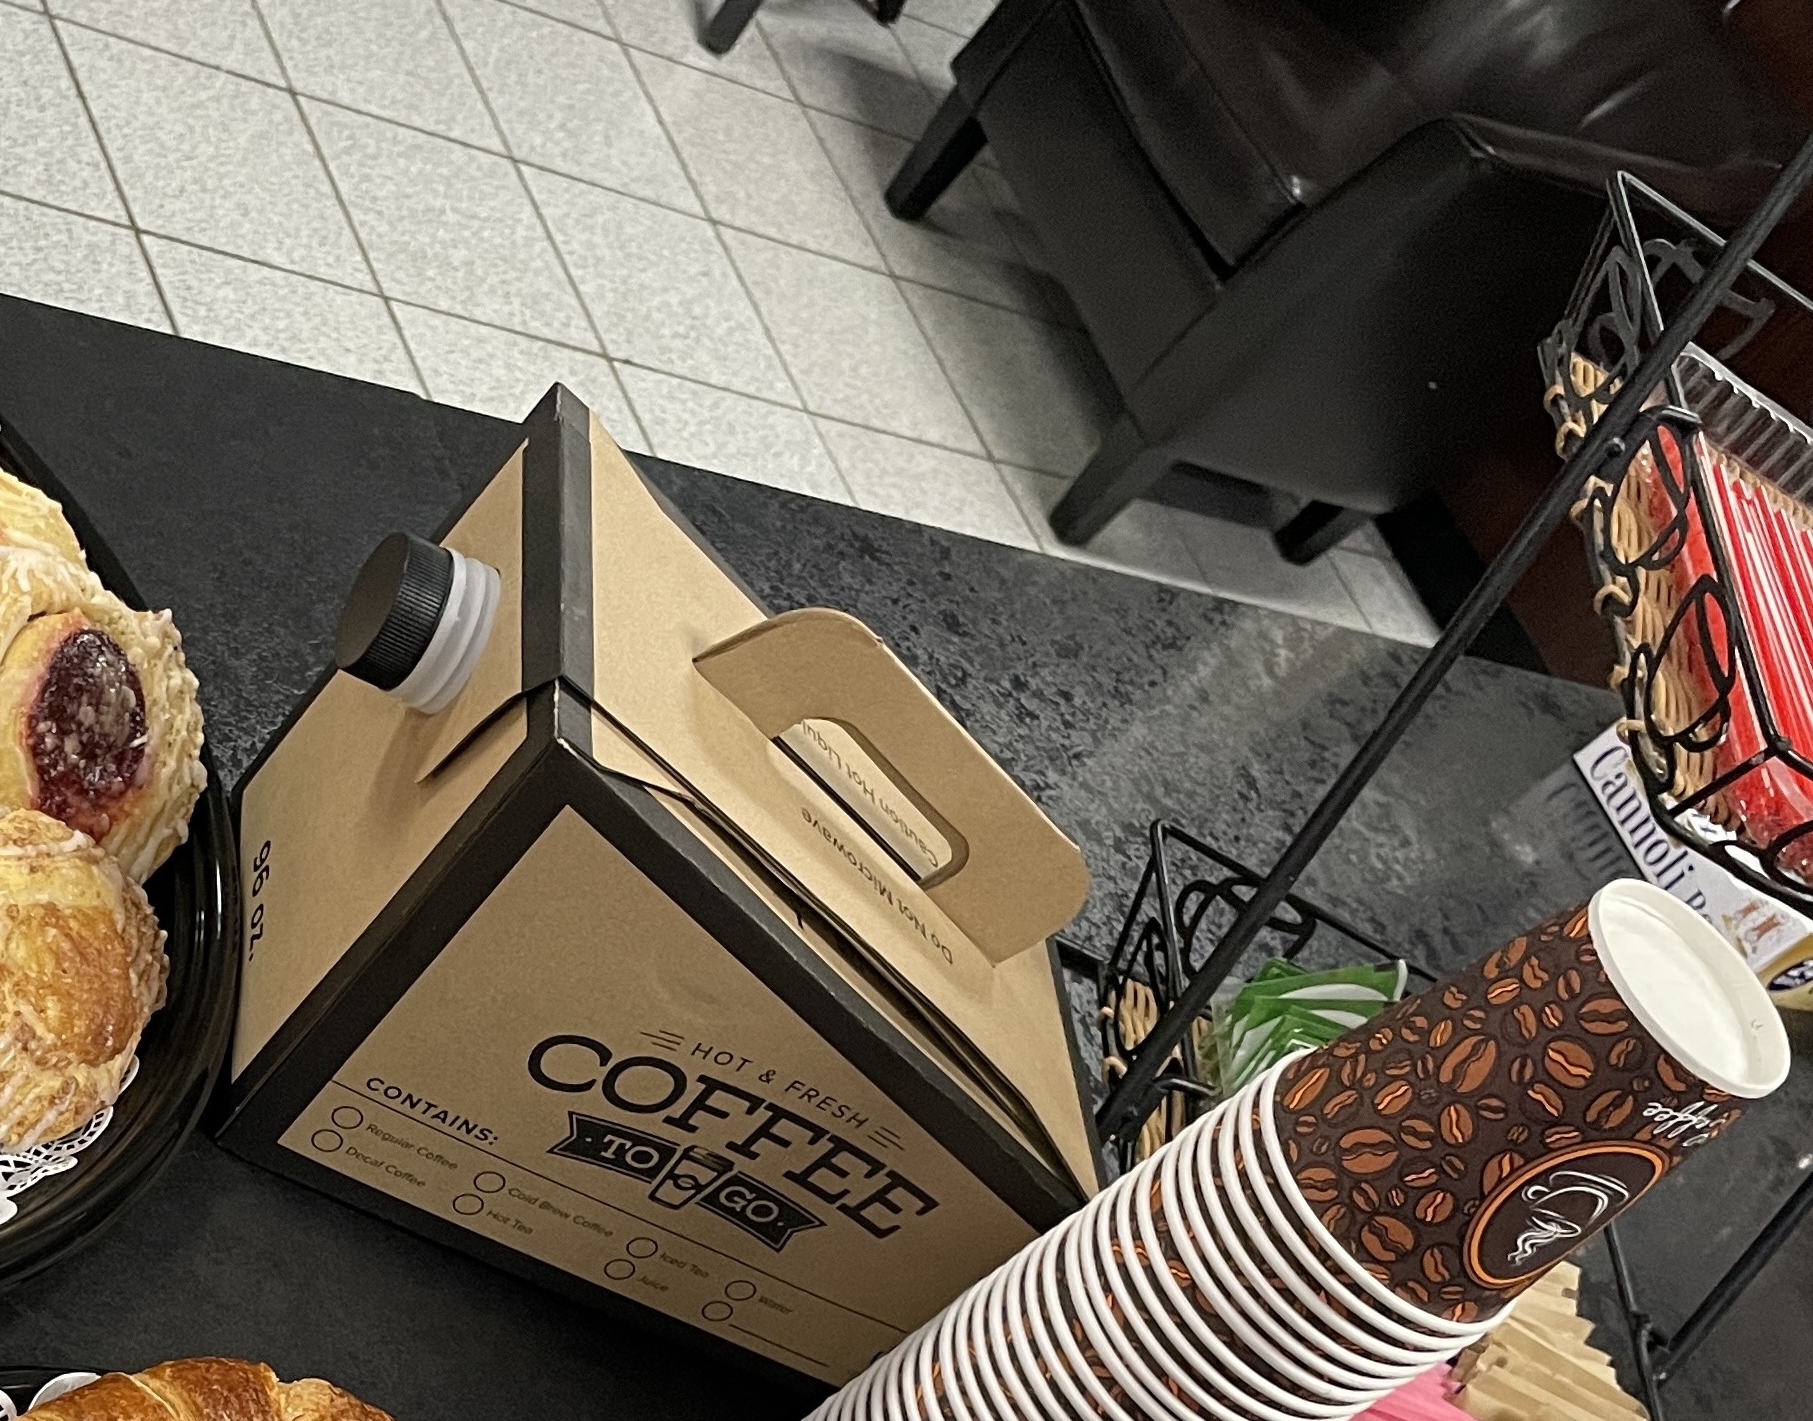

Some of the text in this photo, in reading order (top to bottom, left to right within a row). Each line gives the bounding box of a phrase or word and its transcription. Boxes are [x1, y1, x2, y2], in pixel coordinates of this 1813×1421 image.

[801, 720, 939, 868] Caution Hot Liqui
[1590, 744, 1695, 891] Cannoli
[251, 839, 271, 897] 96
[801, 806, 954, 965] Do Not Microwave
[366, 1077, 499, 1146] CONTAINS:
[690, 1042, 870, 1129] HOT & FRESH
[345, 1145, 426, 1188] Decaf Coffee
[365, 1123, 459, 1171] Regular Coffee
[527, 1033, 940, 1239] COFFEE
[600, 1134, 781, 1223] TO GO
[486, 1209, 534, 1235] Hot Tea
[507, 1185, 615, 1238] Cold Brew Coffee
[637, 1275, 670, 1292] Juice
[659, 1252, 710, 1279] Iced Tea
